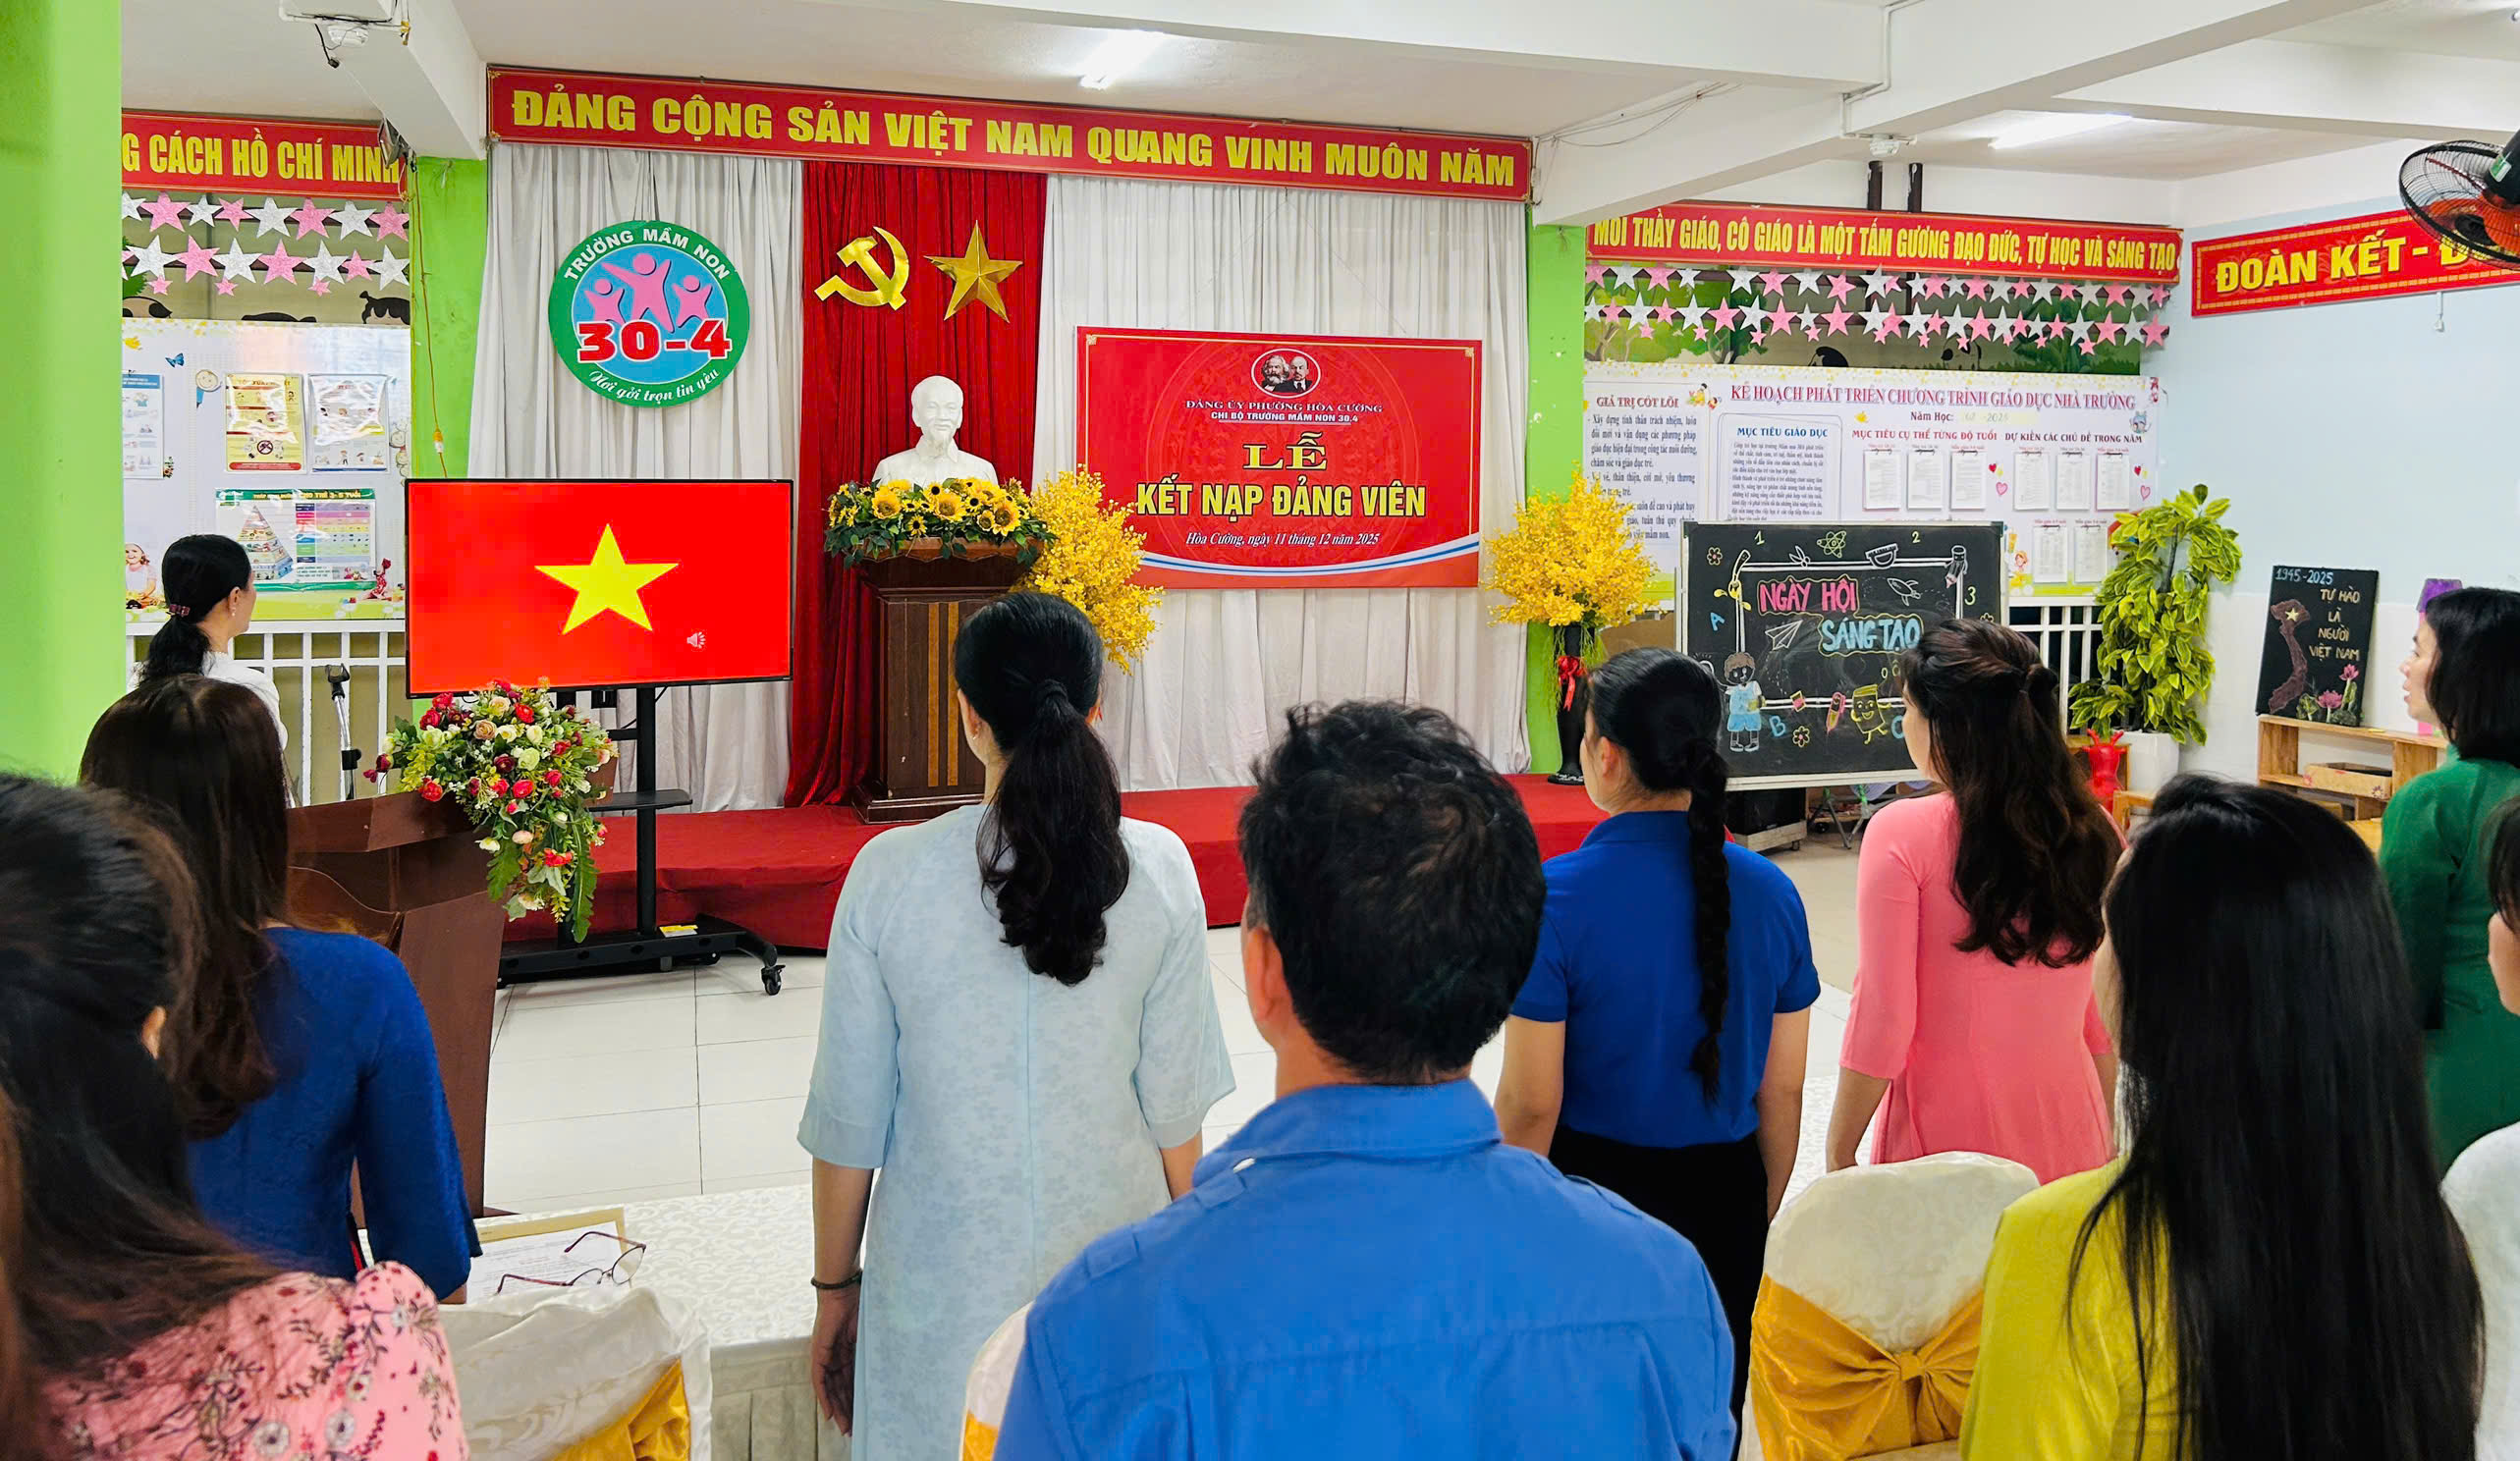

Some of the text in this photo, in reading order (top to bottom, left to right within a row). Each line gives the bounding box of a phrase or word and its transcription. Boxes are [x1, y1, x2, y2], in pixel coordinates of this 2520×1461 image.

[512, 83, 1514, 187] ĐẢNG CỘNG SẢN VIỆT NAM QUANG VINH MUÔN NĂM
[149, 130, 223, 175] CÁCH
[232, 128, 268, 178] HỒ
[277, 137, 323, 181] CHÍ
[1633, 208, 1675, 248] THẦY
[1679, 215, 1722, 253] GIÁO,
[1726, 216, 1749, 251] CÔ
[1754, 215, 1792, 252] GIÁO
[1797, 219, 1816, 253] LÀ
[1820, 221, 1856, 261] MỘT
[1860, 217, 1892, 257] TẤM
[1896, 226, 1949, 259] GƯƠNG
[1953, 232, 1984, 265] ĐẠO
[1988, 231, 2022, 264] ĐỨC,
[2027, 233, 2048, 269] TỰ
[2050, 236, 2080, 271] HỌC
[2084, 235, 2103, 267] VÀ
[2107, 237, 2144, 270] SÁNG
[2149, 242, 2176, 277] TẠO
[564, 227, 731, 281] TRƯỜNG MẦM NON
[2216, 248, 2318, 294] ĐOÀN
[2330, 228, 2406, 279] KẾT
[577, 319, 732, 362] 30-4
[589, 369, 618, 393] Nơi
[643, 391, 673, 405] trọn
[676, 382, 694, 399] tin
[696, 369, 720, 393] yêu
[1186, 399, 1224, 409] ĐẢNG
[1249, 401, 1303, 411] PHƯỜNG
[1307, 402, 1334, 411] HÒA
[1338, 402, 1383, 412] CƯỜNG
[1596, 395, 1616, 406] GIÁ
[1617, 397, 1634, 408] TRỊ
[1753, 386, 1802, 406] HOẠCH
[1806, 384, 1841, 402] PHÁT
[1888, 389, 1945, 406] CHƯƠNG
[1947, 387, 1987, 406] TRÌNH
[1991, 389, 2022, 407] GIÁO
[2026, 392, 2053, 411] DỤC
[2054, 390, 2081, 408] NHÀ
[2083, 391, 2135, 410] TRƯỜNG
[1232, 410, 1244, 421] BỘ
[1247, 411, 1286, 420] TRƯỜNG
[1288, 410, 1312, 421] MẦM
[1736, 425, 1828, 439] MỤC TIÊU GIÁO DỤC
[1852, 430, 1872, 440] MỤC
[1876, 429, 1895, 439] TIÊU
[1898, 430, 1909, 440] CỤ
[2044, 431, 2057, 442] CÁC
[2094, 434, 2121, 443] TRONG
[1242, 432, 1327, 470] LỄ
[1137, 473, 1426, 522] KẾT NẠP ĐẢNG VIÊN
[1186, 532, 1381, 548] Hòa Cường, ngày 11 tháng 12 năm 2025
[1754, 530, 1765, 545] 1
[1911, 531, 1921, 544] 2
[2275, 568, 2333, 585] 1945-2025
[1759, 577, 1857, 613] NGÀY HỘI
[1964, 587, 1976, 606] 3
[2321, 585, 2361, 604] TỰ HÀO
[1710, 612, 1726, 631] A
[2328, 607, 2341, 622] LÀ
[1822, 617, 1922, 652] SÁNG TẠO
[2318, 624, 2349, 641] NGƯỜI
[2309, 643, 2359, 662] VIỆT NAM
[1770, 715, 1787, 737] B
